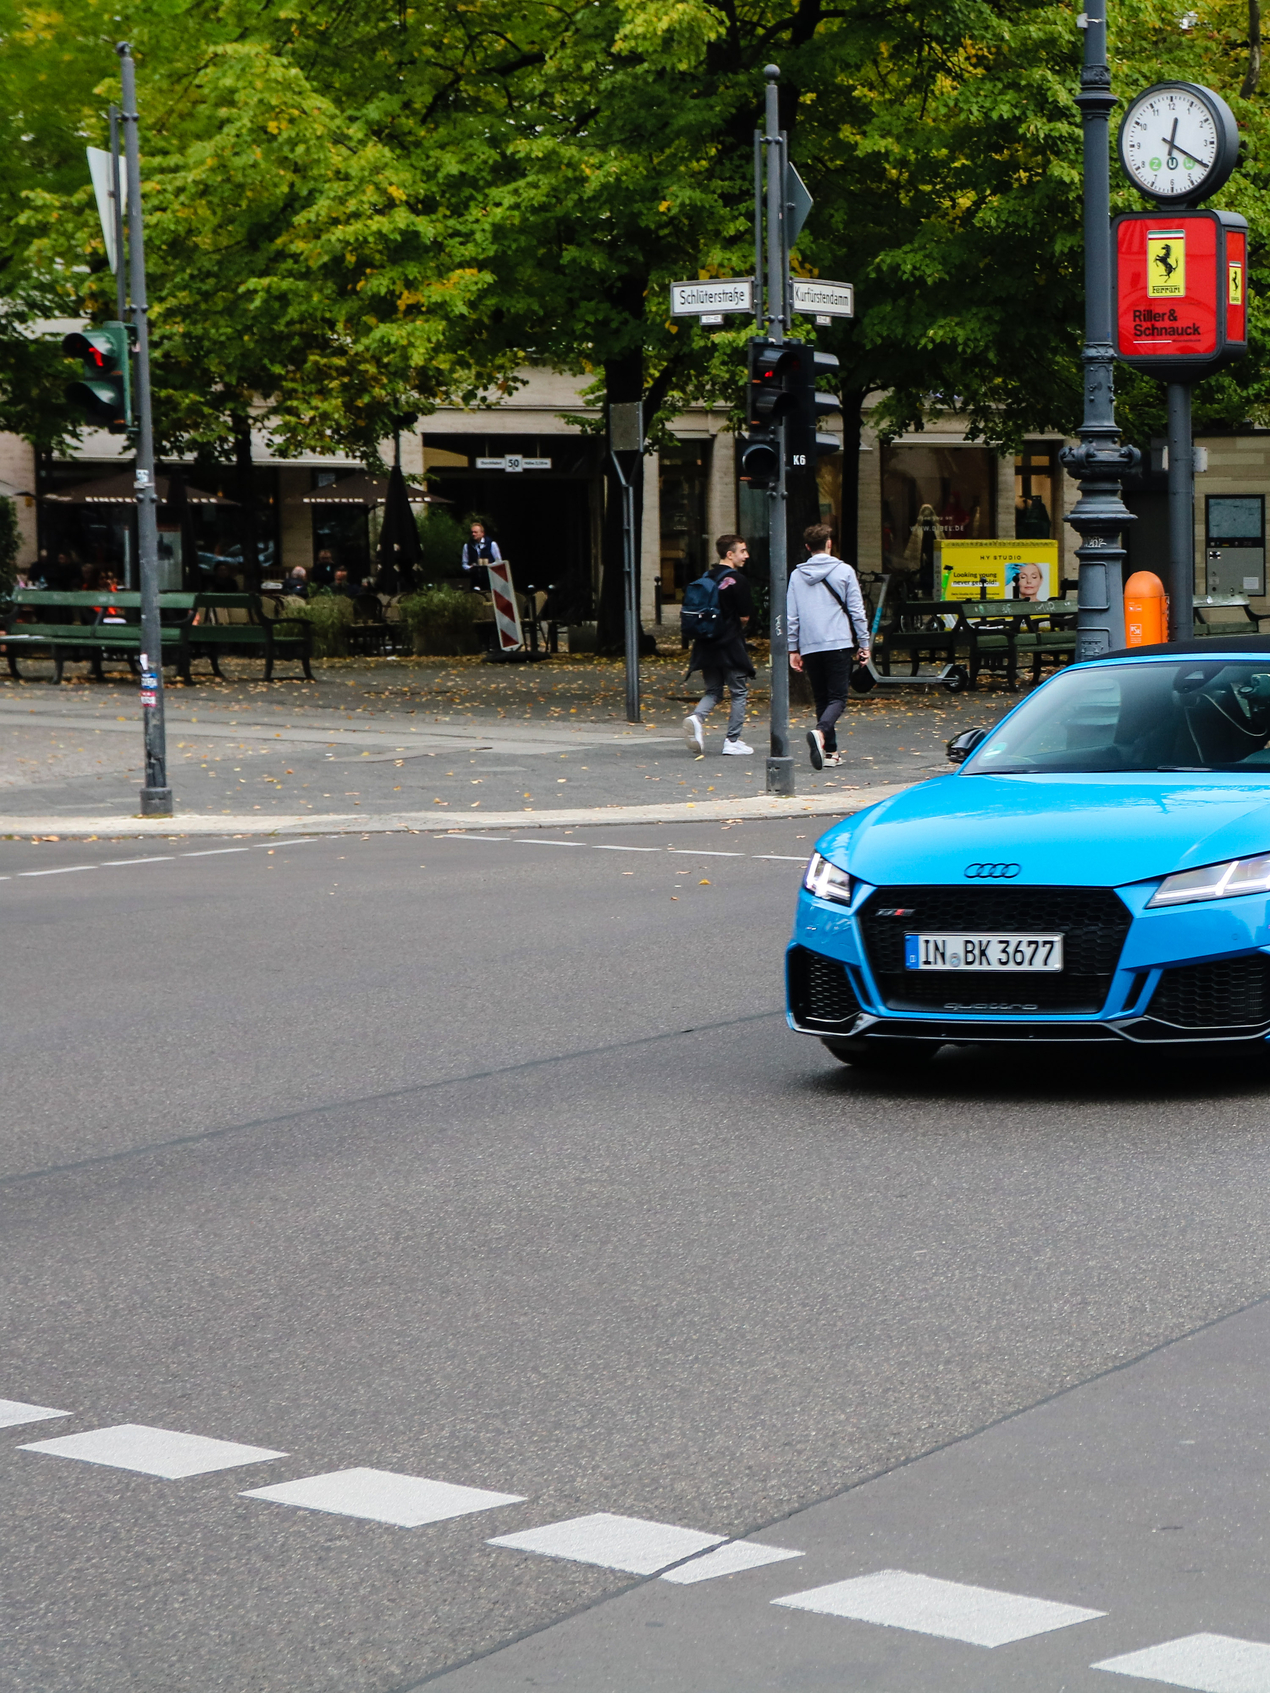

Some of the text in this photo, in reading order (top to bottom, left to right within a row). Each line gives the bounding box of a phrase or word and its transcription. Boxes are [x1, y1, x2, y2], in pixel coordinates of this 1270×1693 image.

[679, 287, 745, 305] Schlüterstraße
[795, 286, 848, 306] Kurfürstendamm
[1152, 285, 1181, 294] Ferrari
[1133, 309, 1167, 322] Riller
[1133, 323, 1201, 337] Schnauck
[508, 459, 519, 467] 50
[793, 455, 806, 466] K6
[953, 571, 978, 579] Looking
[922, 939, 1054, 966] IN BK 3677
